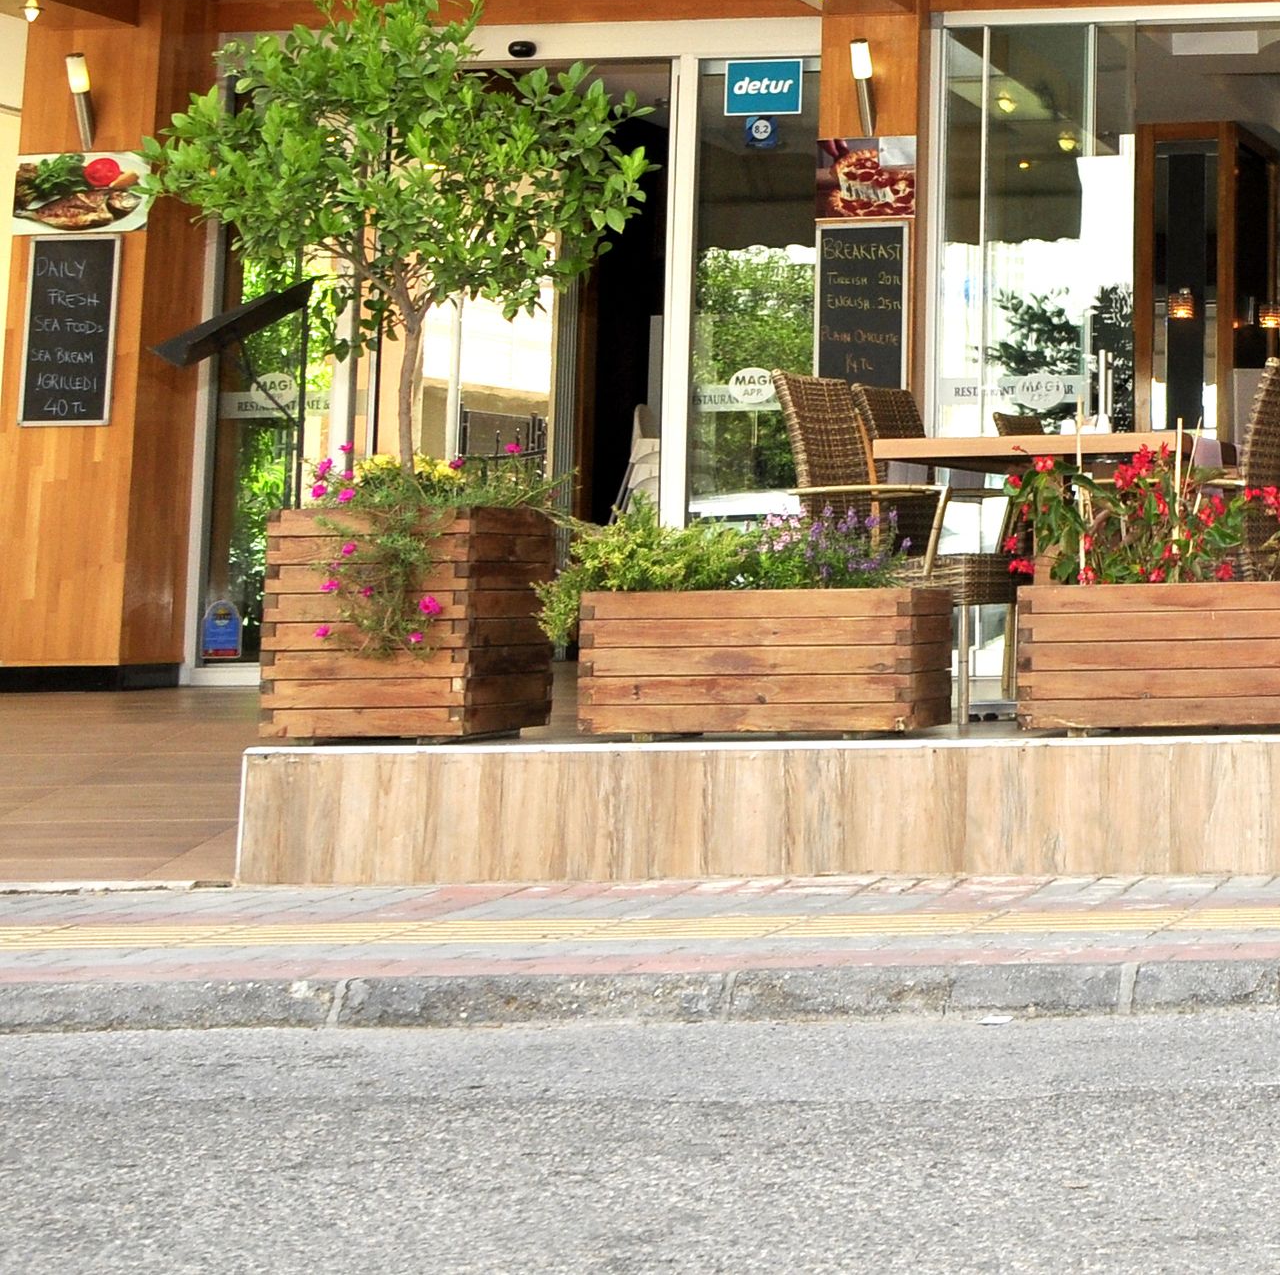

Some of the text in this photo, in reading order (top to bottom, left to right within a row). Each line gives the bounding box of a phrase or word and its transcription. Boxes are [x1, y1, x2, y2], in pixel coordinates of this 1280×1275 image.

[733, 77, 793, 95] detur
[754, 125, 769, 134] 8,2
[822, 238, 902, 261] BREAKFAST
[36, 257, 87, 278] DAILY
[48, 288, 100, 308] FRESH
[34, 316, 60, 333] SEA
[31, 347, 94, 364] SEA BREAM
